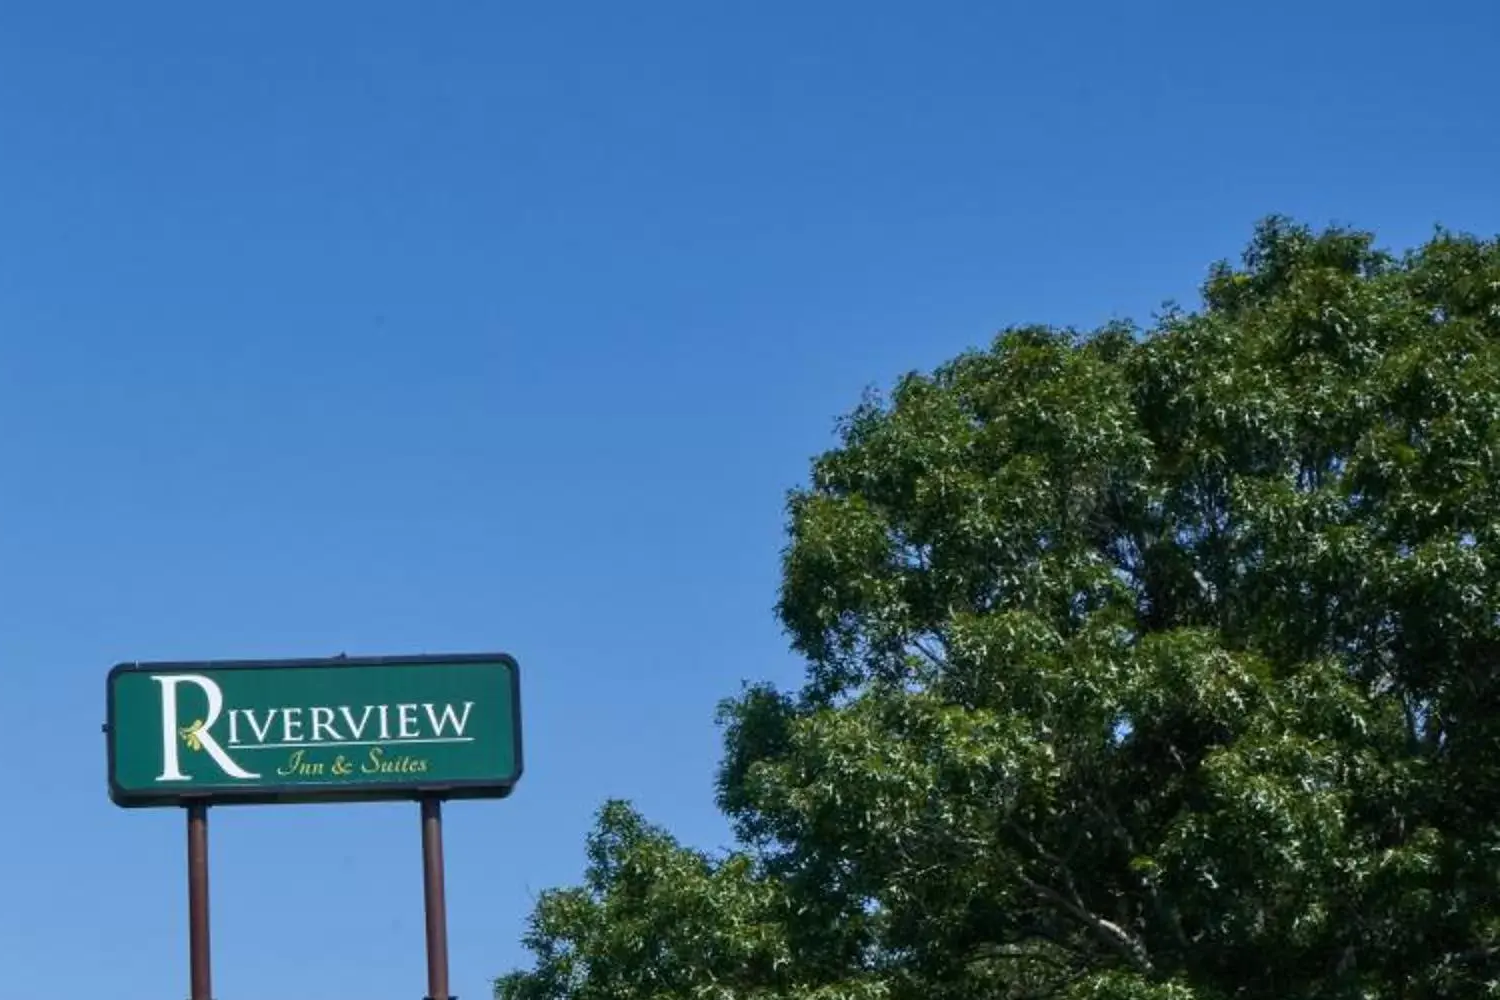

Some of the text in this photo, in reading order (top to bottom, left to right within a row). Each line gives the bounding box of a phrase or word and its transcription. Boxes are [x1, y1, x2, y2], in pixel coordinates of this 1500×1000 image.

[151, 674, 475, 781] RIVERVIEW
[277, 748, 428, 777] Inn & Suites
